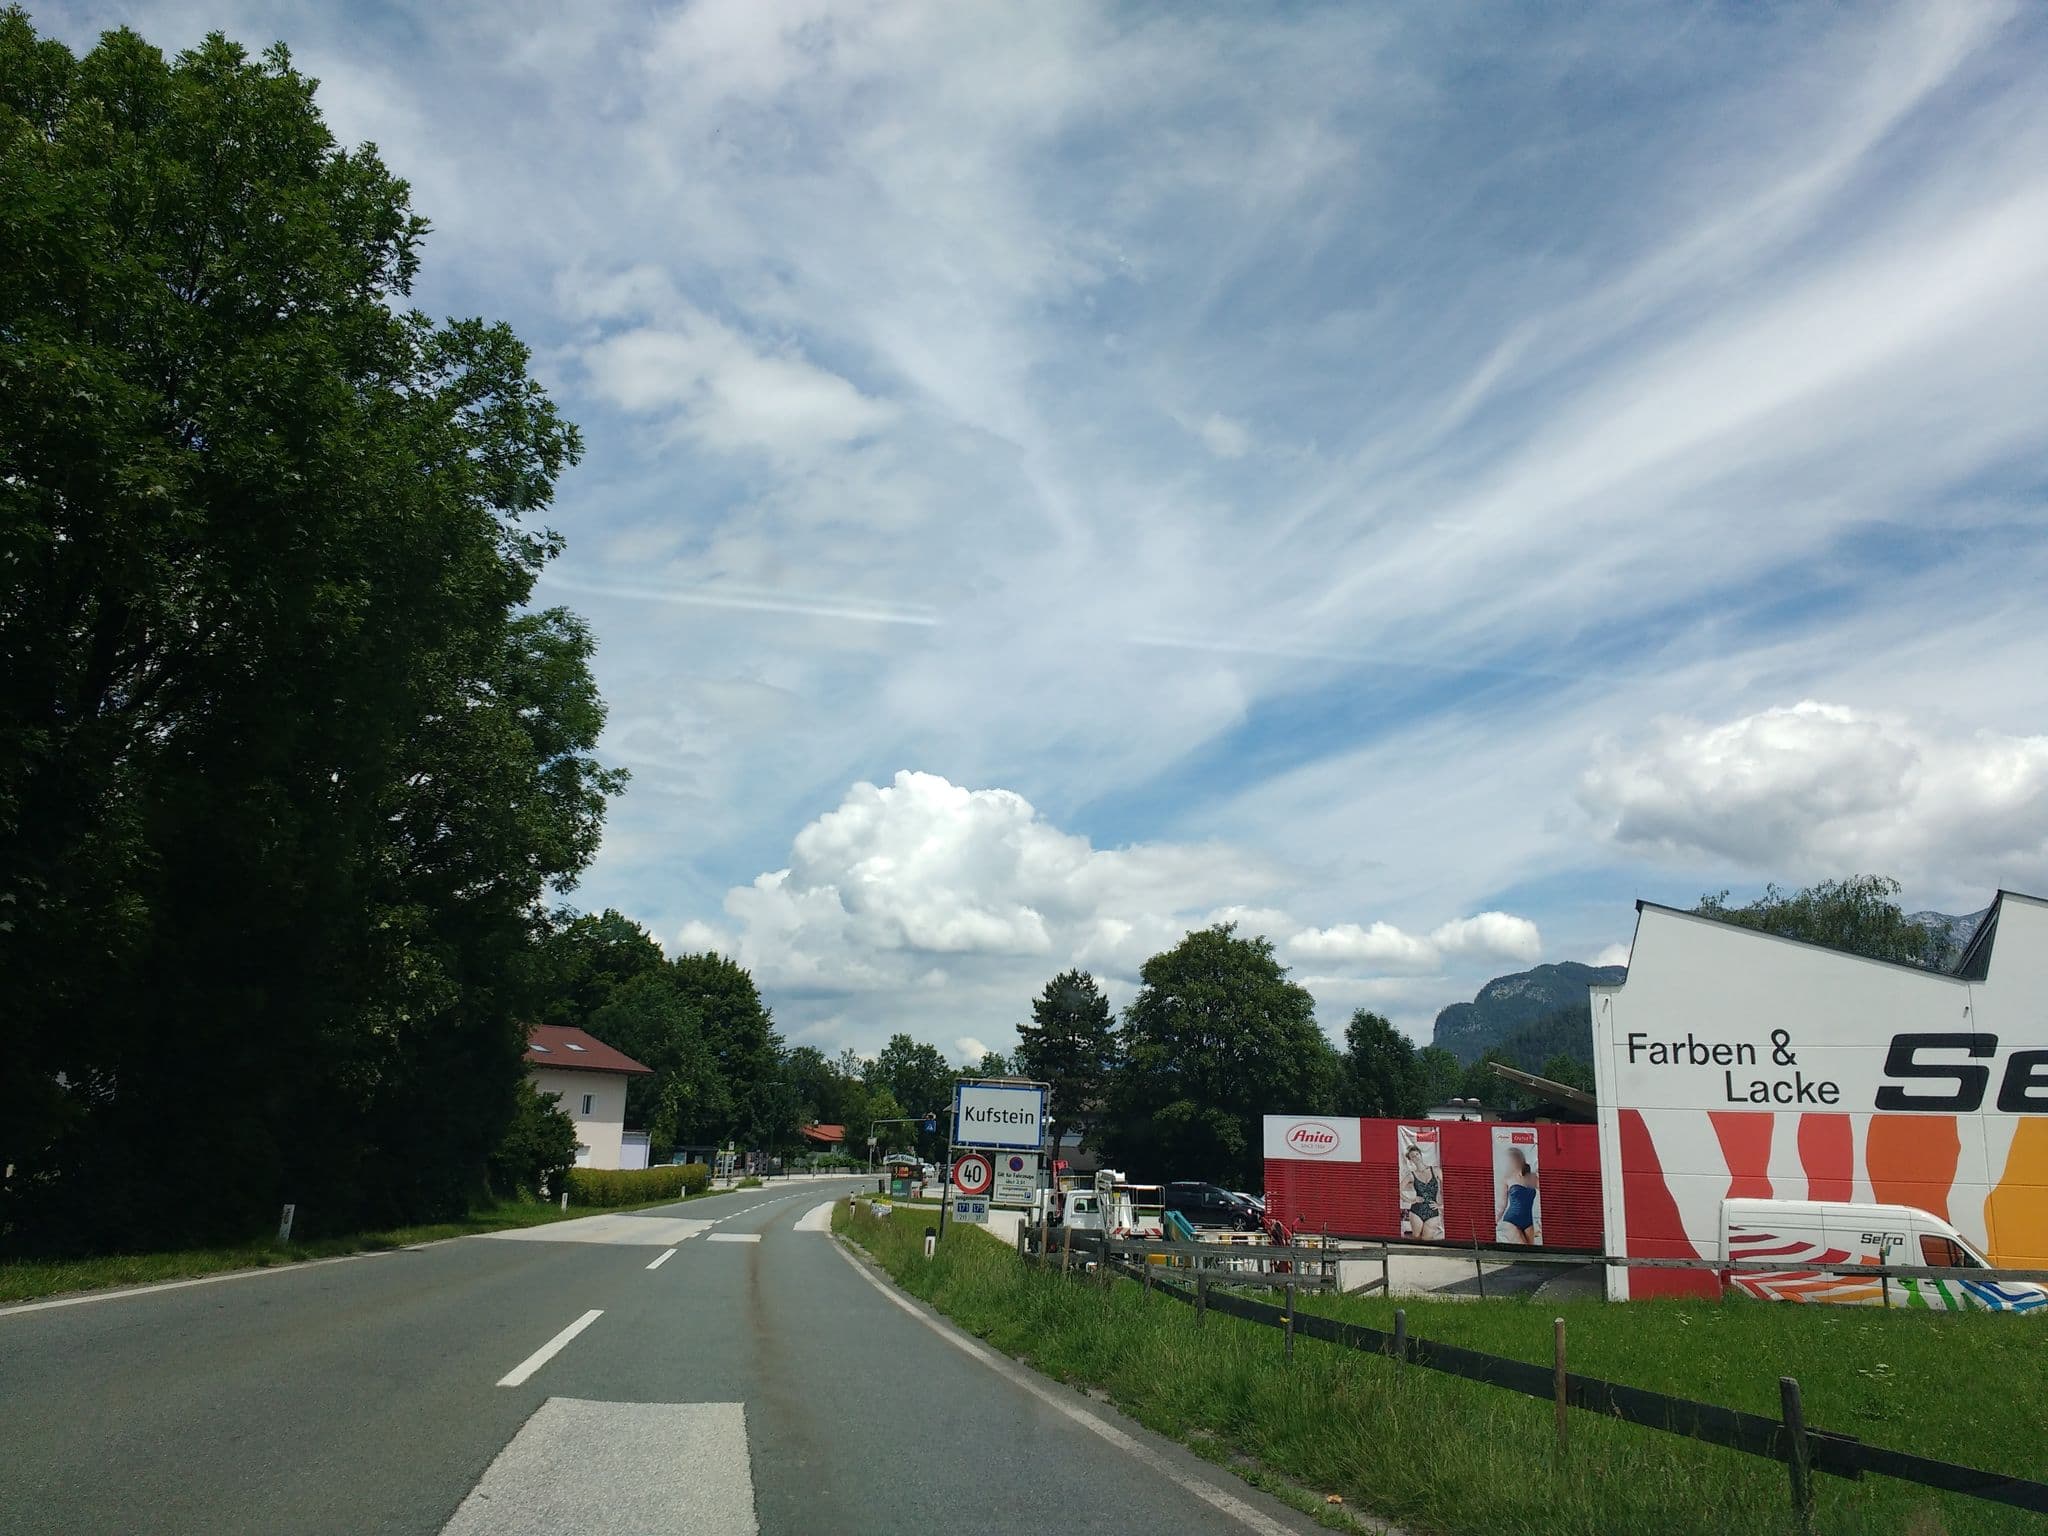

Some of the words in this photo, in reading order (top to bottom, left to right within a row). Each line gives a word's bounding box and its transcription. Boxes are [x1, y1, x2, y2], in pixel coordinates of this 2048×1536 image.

[1627, 1032, 1756, 1066] Farben
[1770, 1028, 1798, 1066] &
[1725, 1070, 1840, 1104] Lacke
[965, 1106, 1034, 1125] Kufstein
[1291, 1129, 1333, 1143] Anita
[964, 1165, 981, 1183] 40
[1861, 1232, 1904, 1247] Sefra
